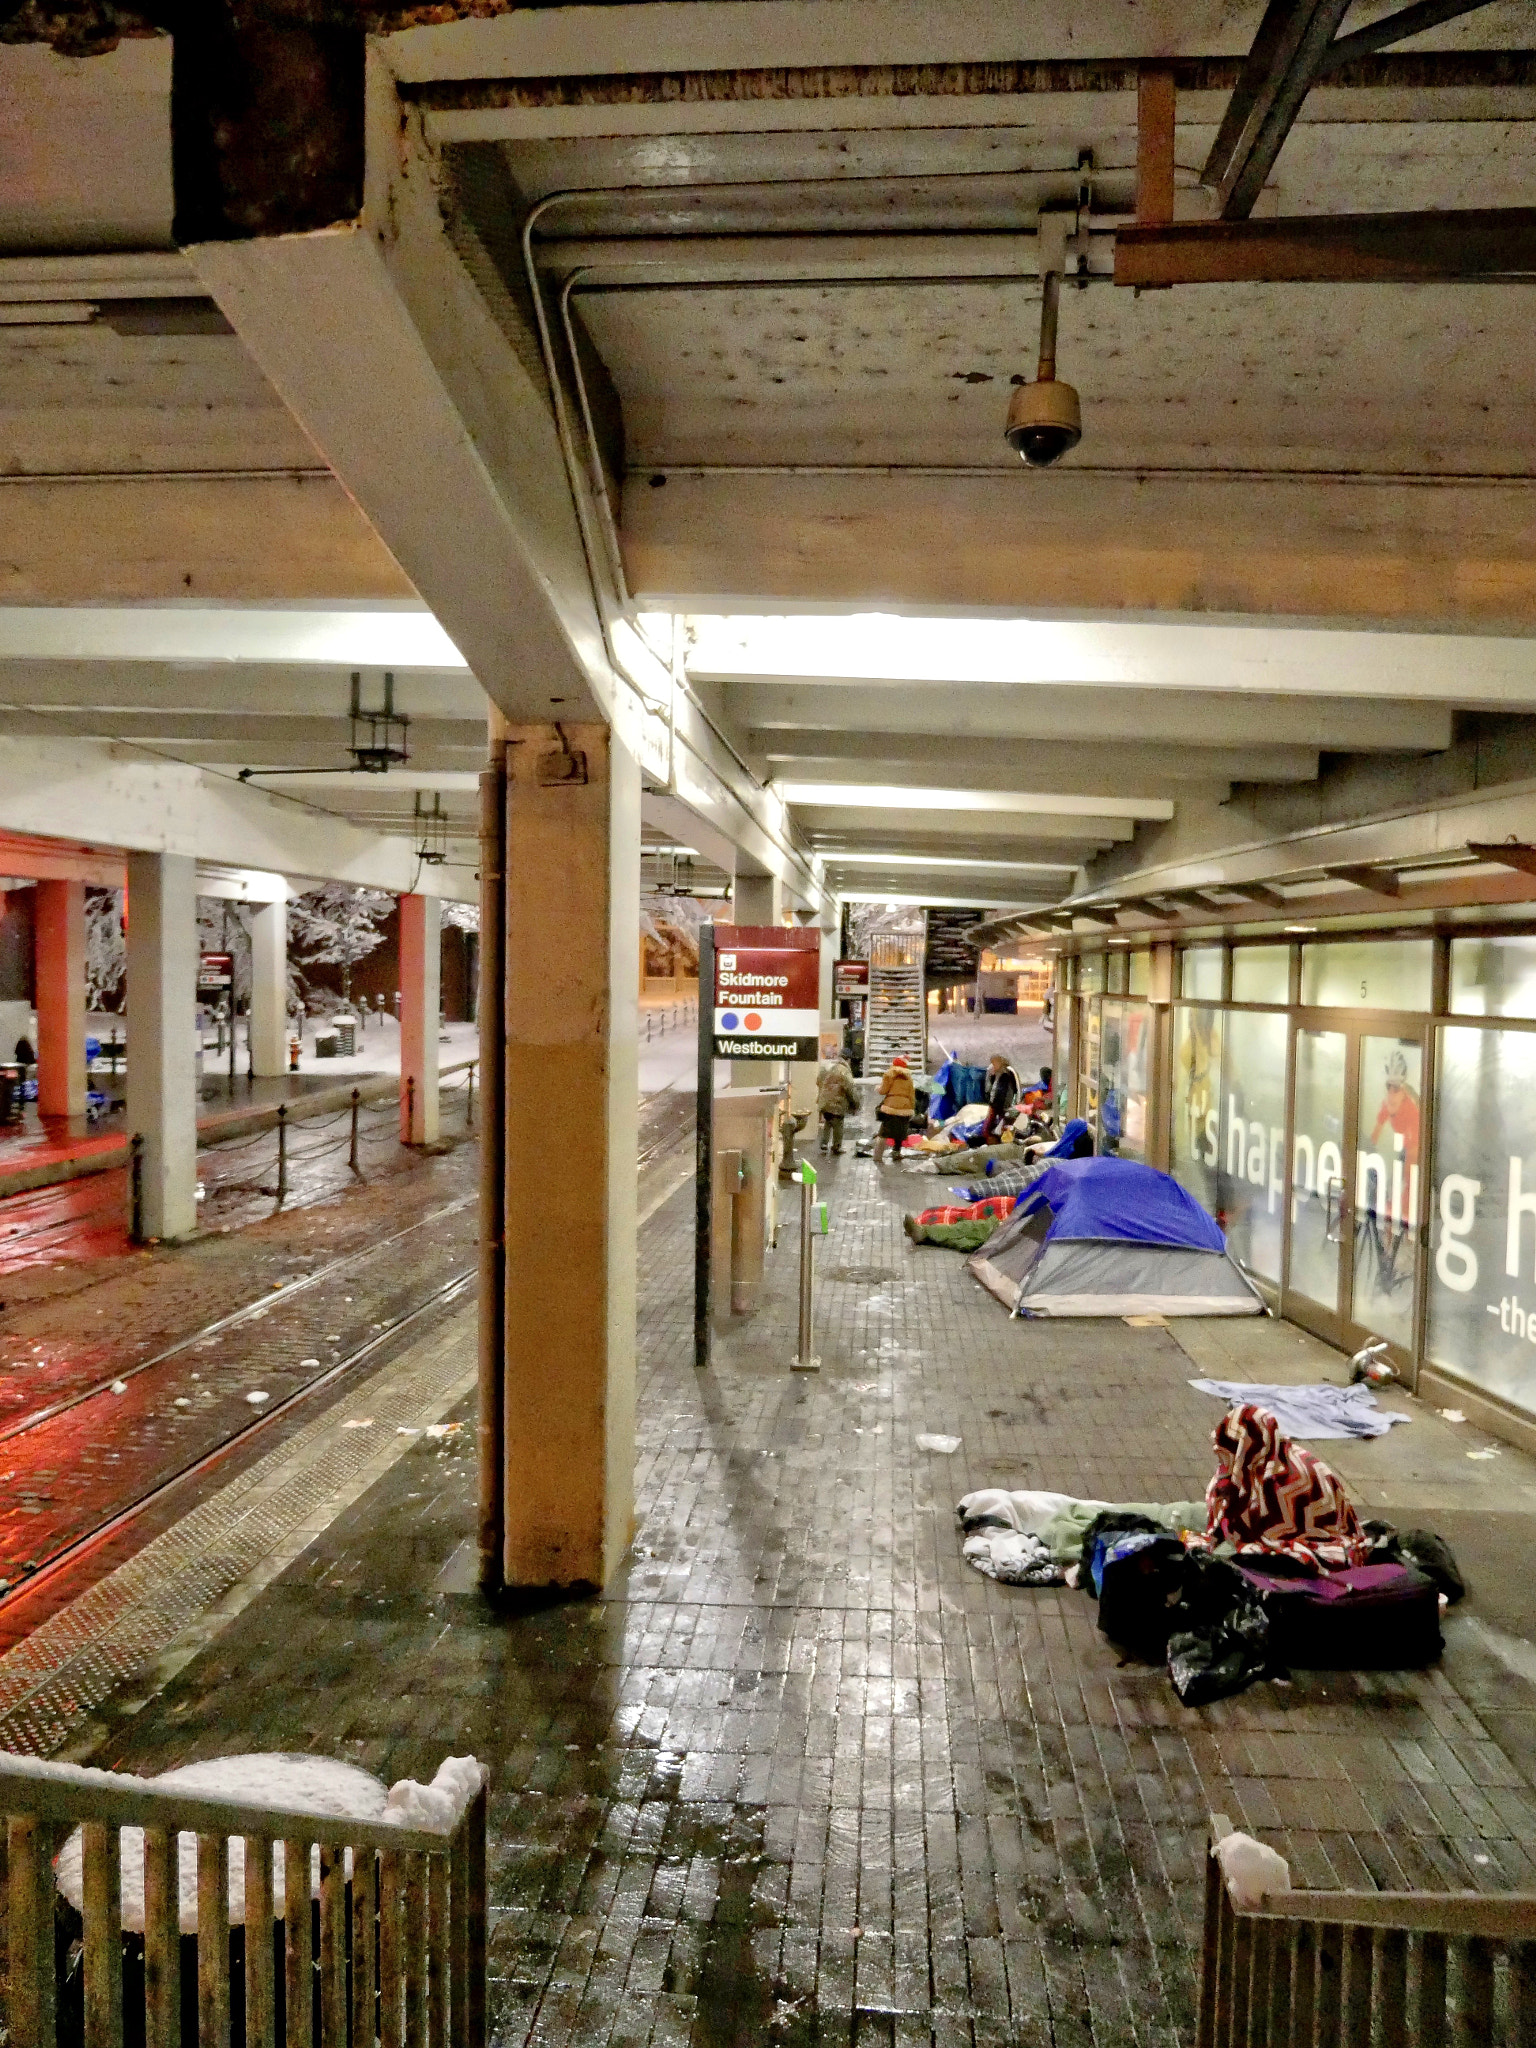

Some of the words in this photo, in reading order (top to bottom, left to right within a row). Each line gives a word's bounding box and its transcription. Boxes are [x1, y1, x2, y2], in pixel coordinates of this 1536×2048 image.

[719, 972, 788, 987] Skidmore
[1360, 980, 1367, 999] 5
[718, 991, 783, 1005] Fountain
[718, 1040, 797, 1055] Westbound
